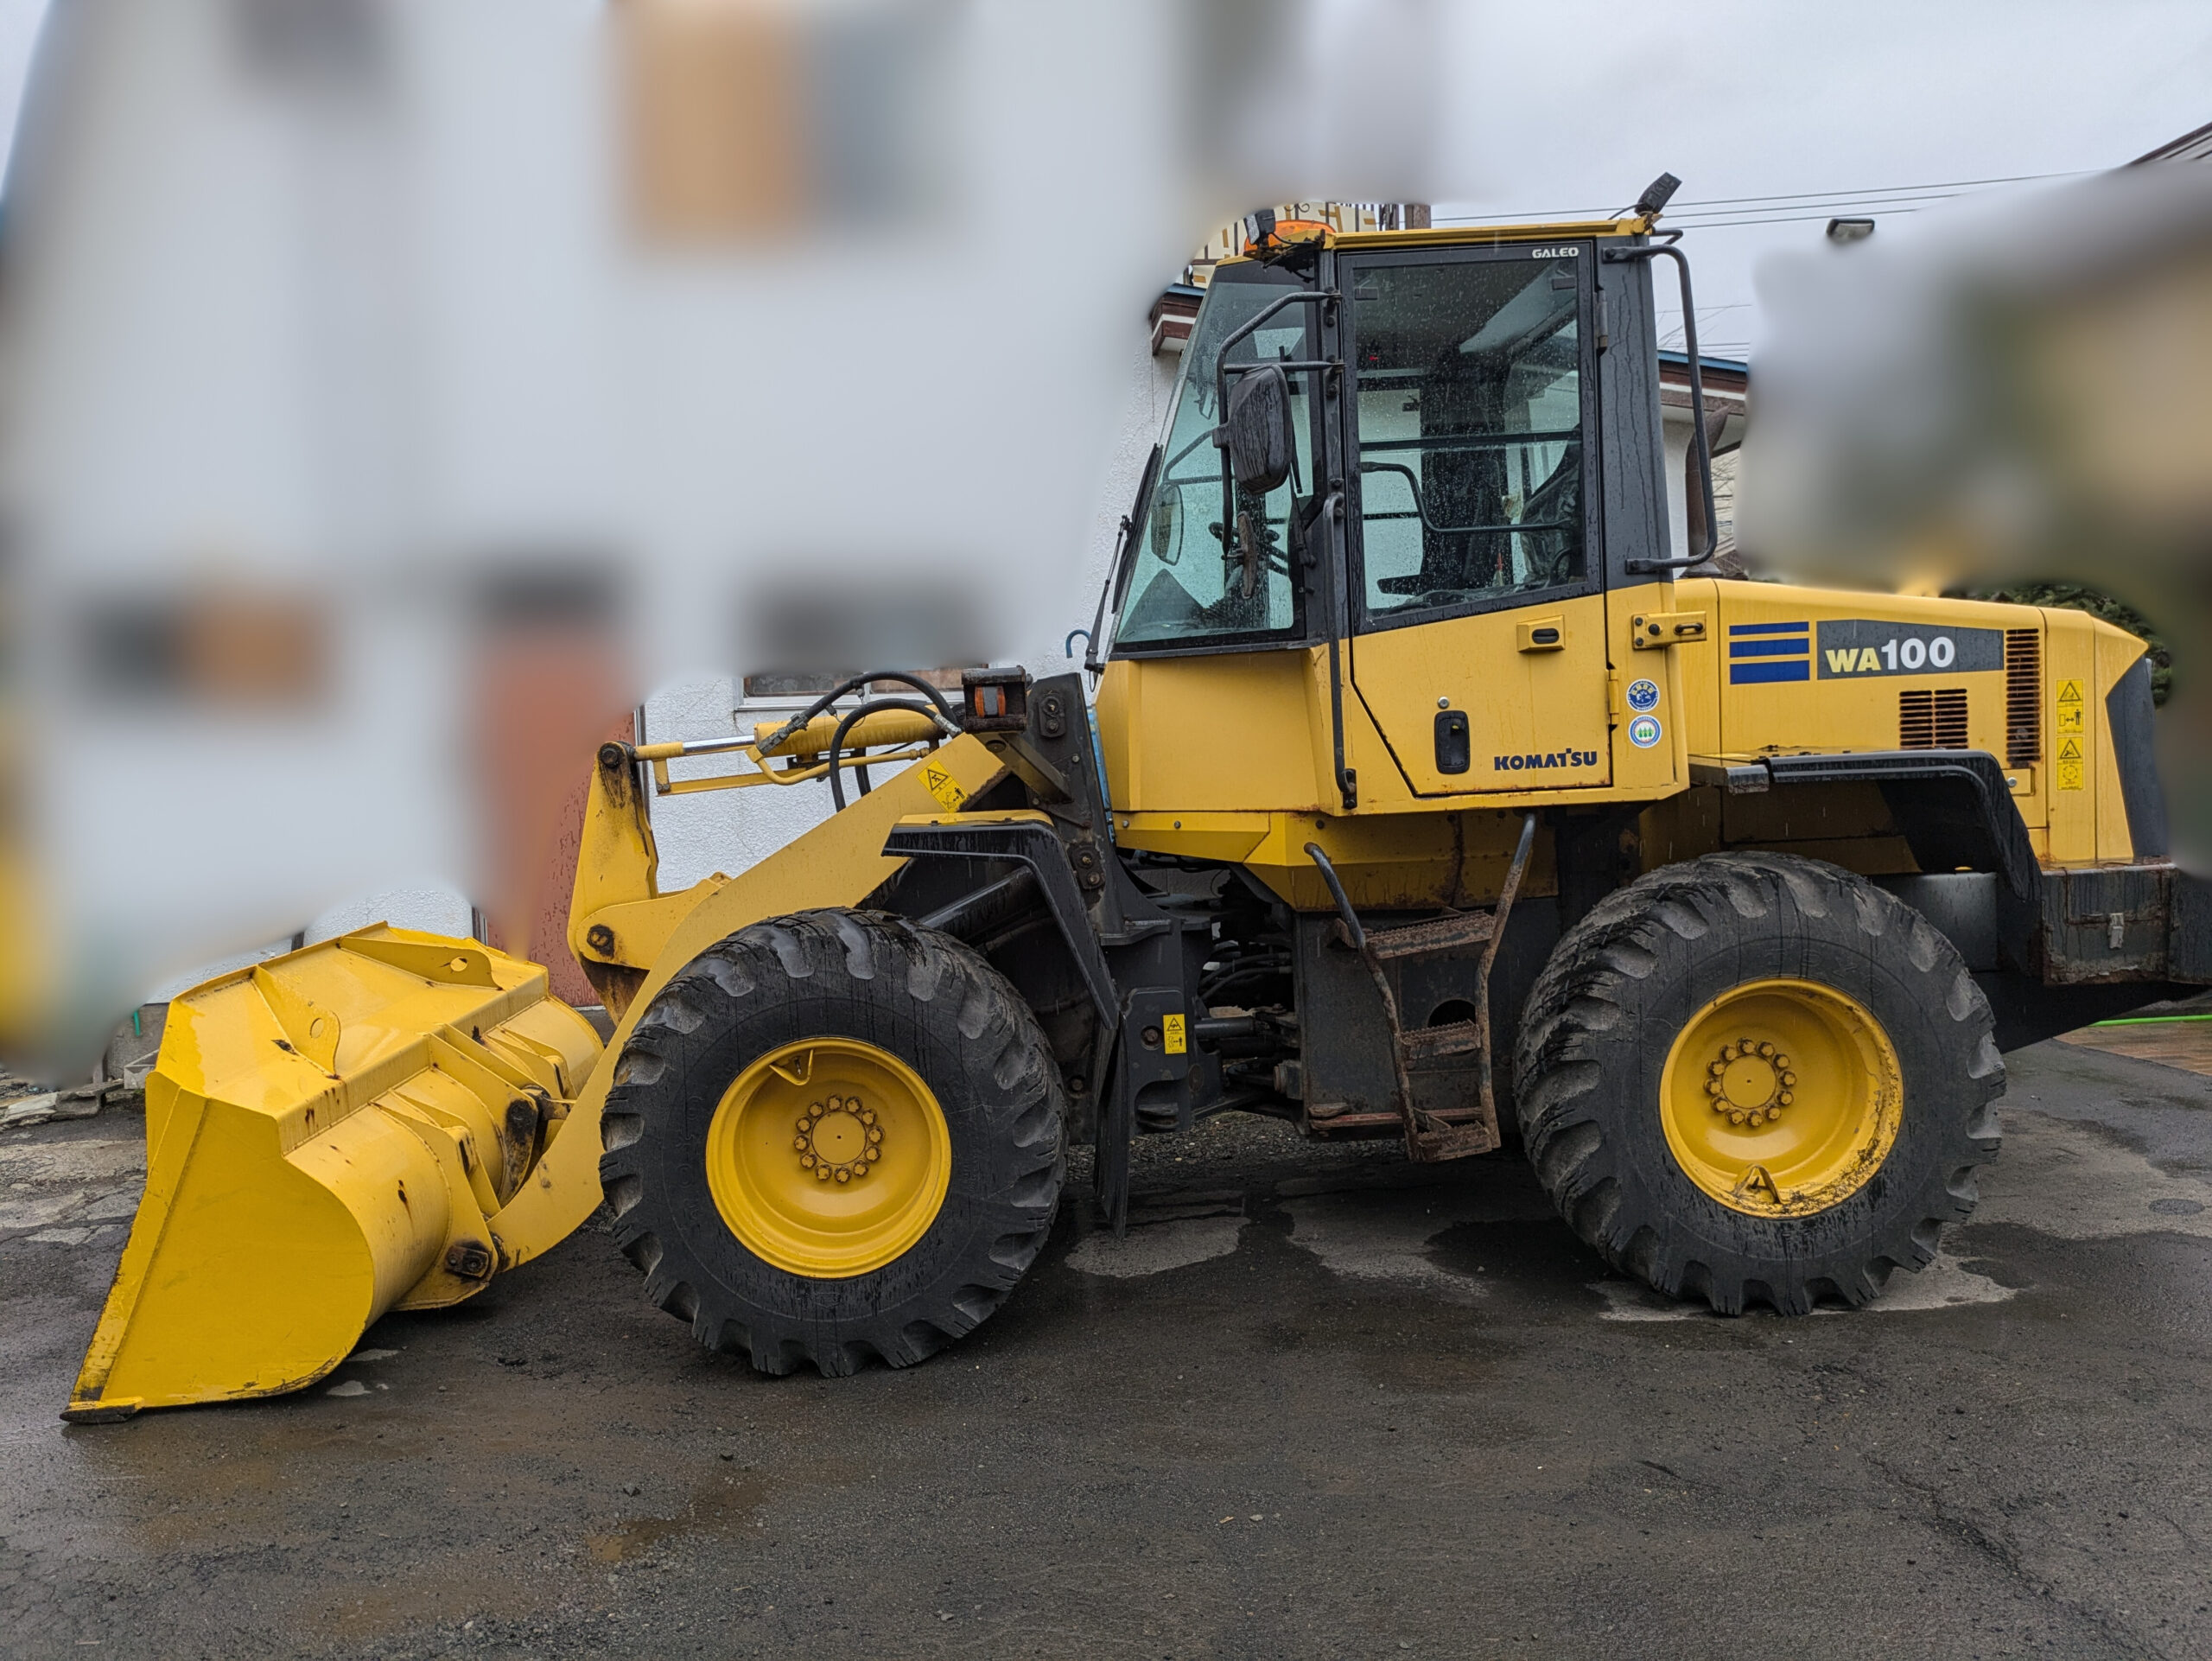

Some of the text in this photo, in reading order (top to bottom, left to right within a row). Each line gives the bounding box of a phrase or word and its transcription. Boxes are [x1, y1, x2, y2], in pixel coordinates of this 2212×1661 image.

[1532, 247, 1580, 258] GALEO
[1825, 636, 1955, 673] WA100
[1494, 748, 1598, 771] KOMATSU
